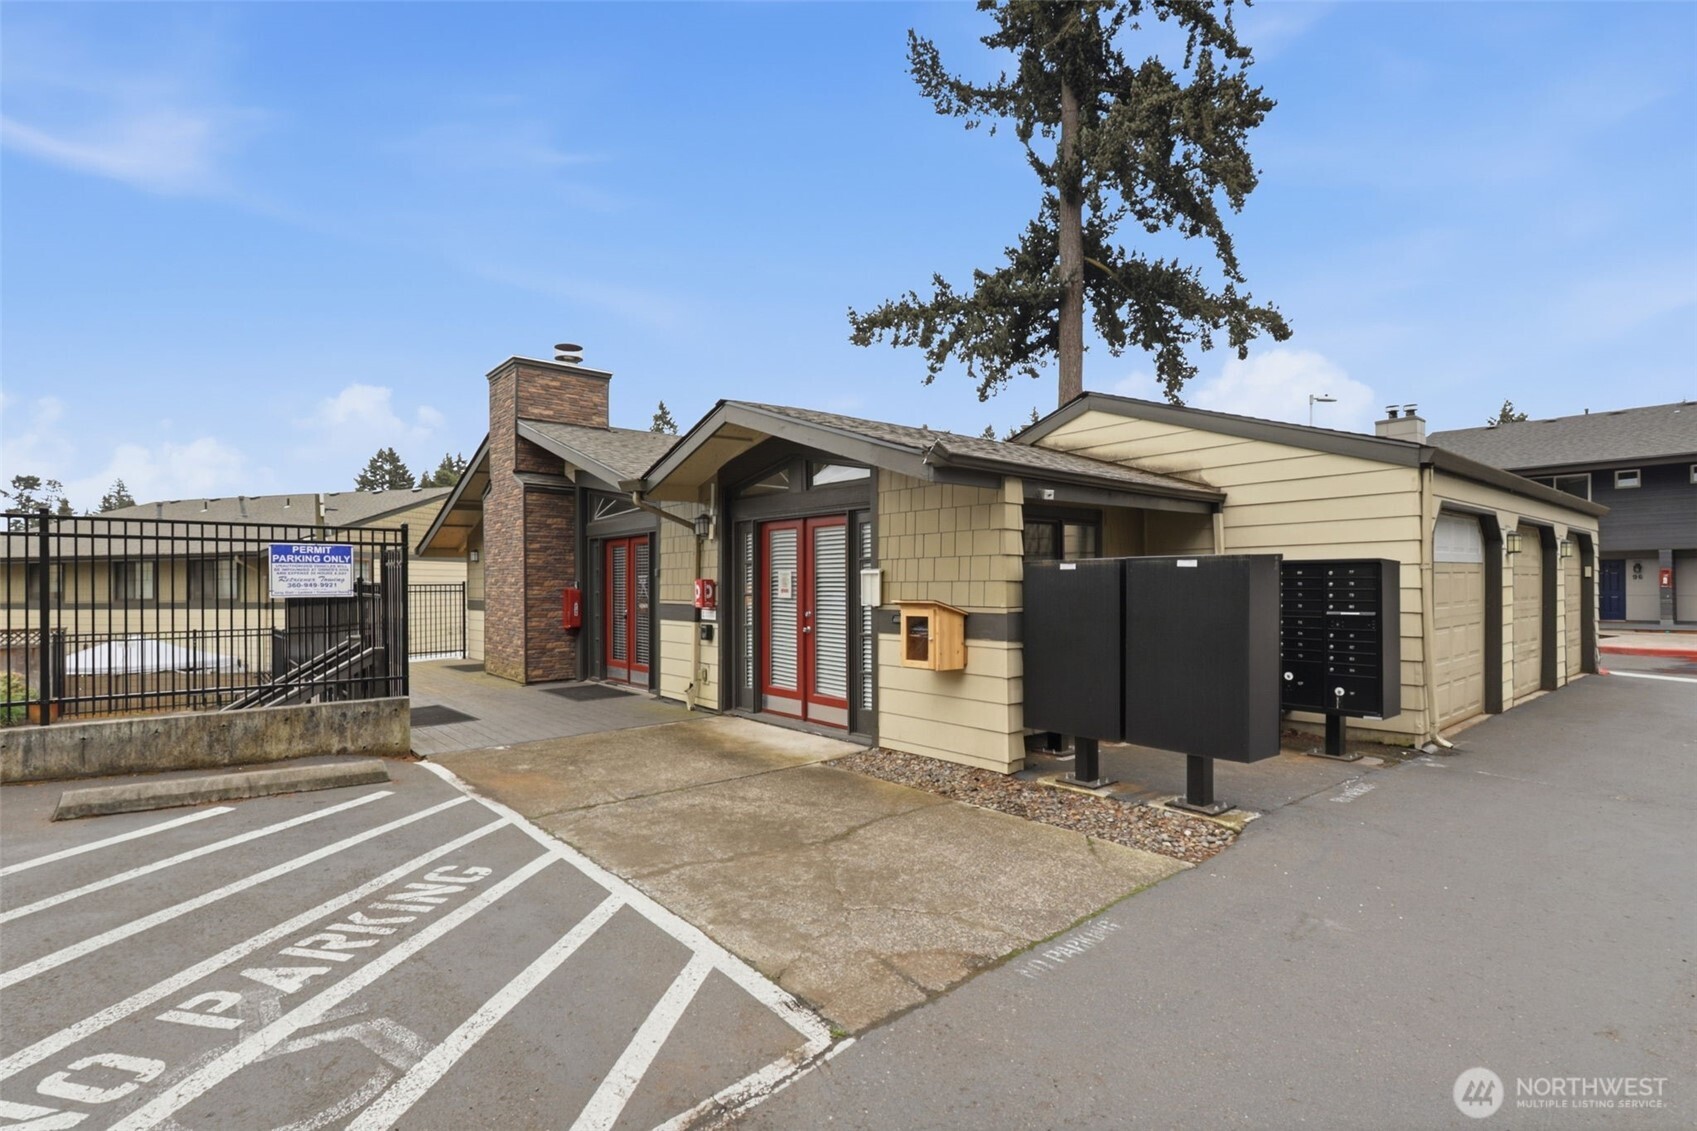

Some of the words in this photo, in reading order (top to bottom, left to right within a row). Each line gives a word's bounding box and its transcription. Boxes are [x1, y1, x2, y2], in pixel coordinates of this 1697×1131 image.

[292, 546, 332, 554] PERMIT
[272, 554, 321, 562] PARKING
[323, 555, 351, 563] ONLY
[155, 865, 493, 1030] PARKING
